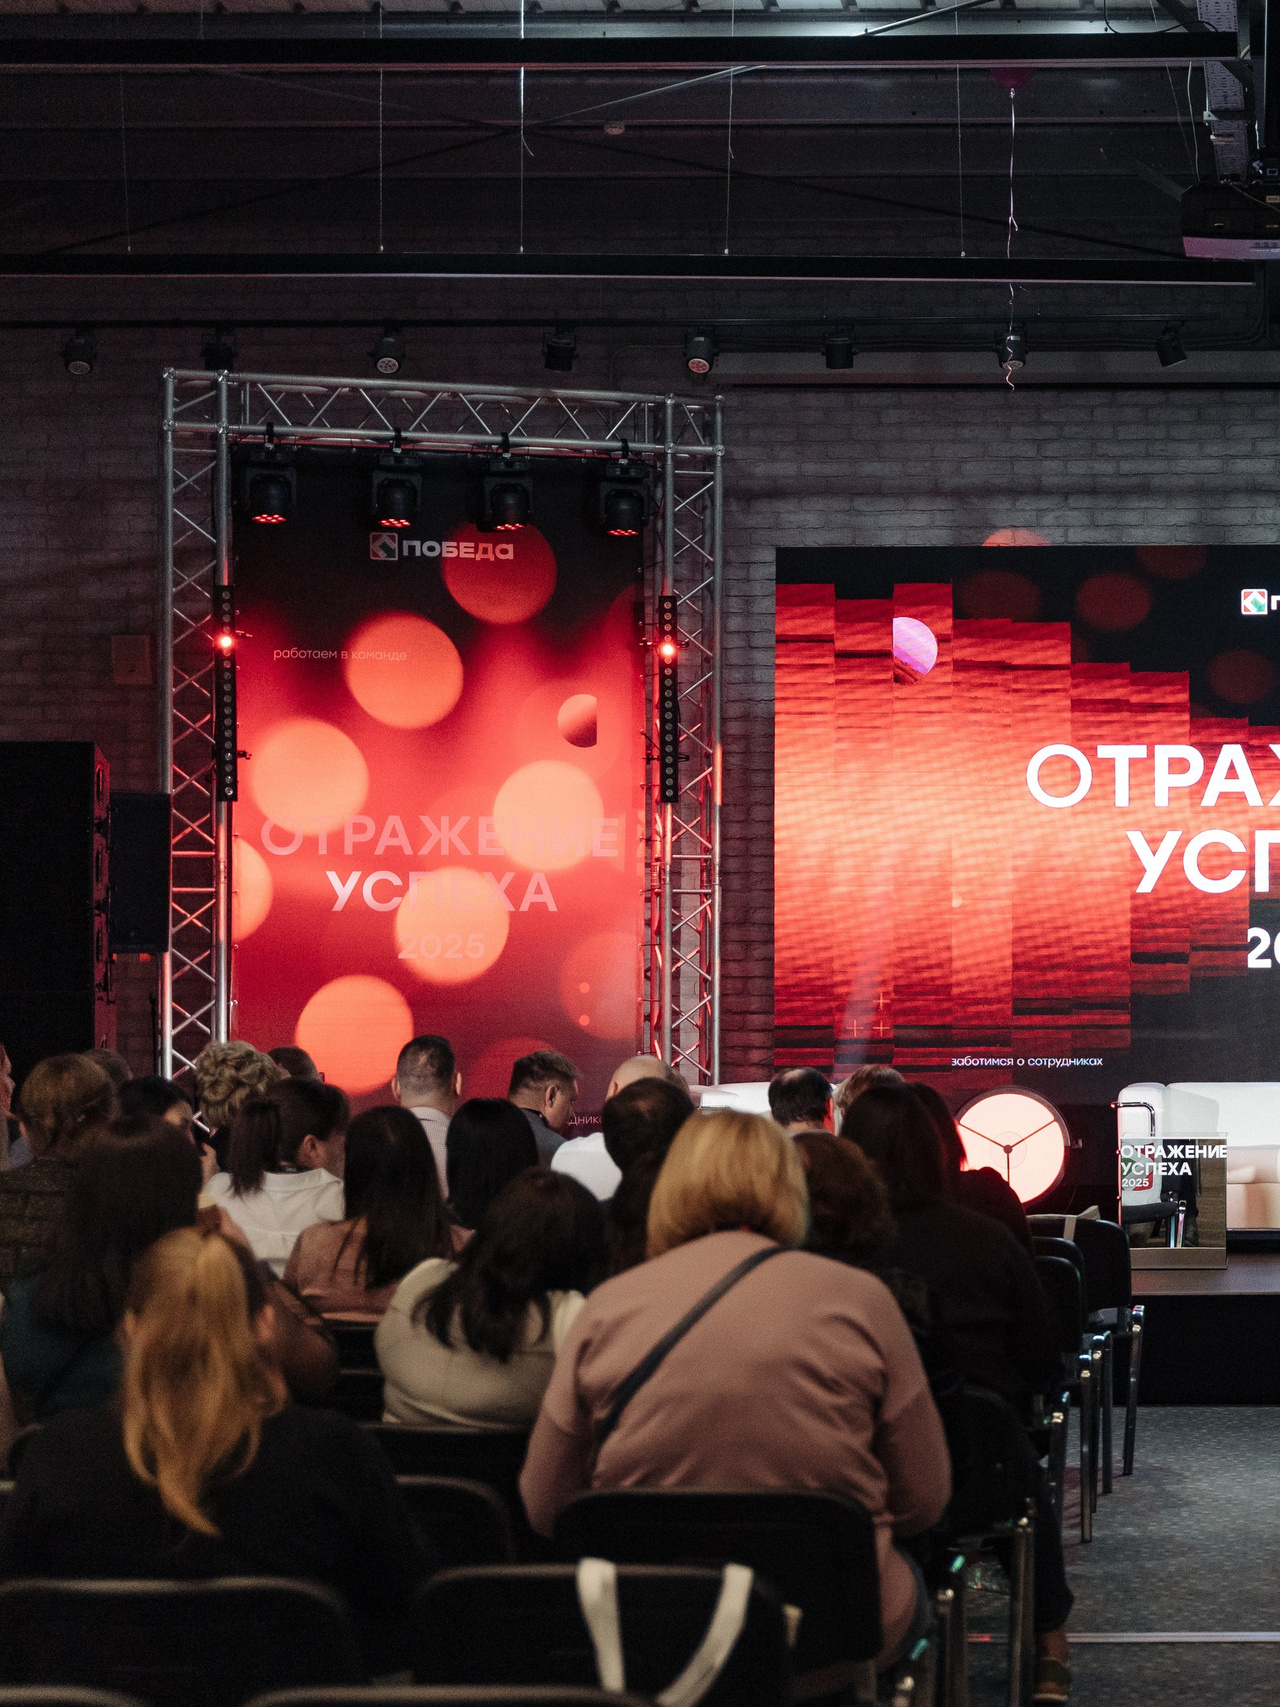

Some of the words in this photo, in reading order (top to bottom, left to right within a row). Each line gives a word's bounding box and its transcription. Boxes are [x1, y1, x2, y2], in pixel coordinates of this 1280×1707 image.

[273, 647, 338, 661] работаем
[341, 651, 348, 659] в
[351, 650, 407, 661] команде
[260, 815, 620, 858] ОТРАЖЕНИЕ
[325, 870, 559, 912] УСПЕХА
[397, 933, 486, 961] 2025
[951, 1055, 1014, 1067] заботимся
[1017, 1058, 1025, 1066] о
[1027, 1057, 1103, 1069] сотрудниках
[1120, 1144, 1228, 1159] ОТРАЖЕНИЕ
[1120, 1161, 1193, 1176] УСПЕХА
[1122, 1178, 1149, 1187] 2025
